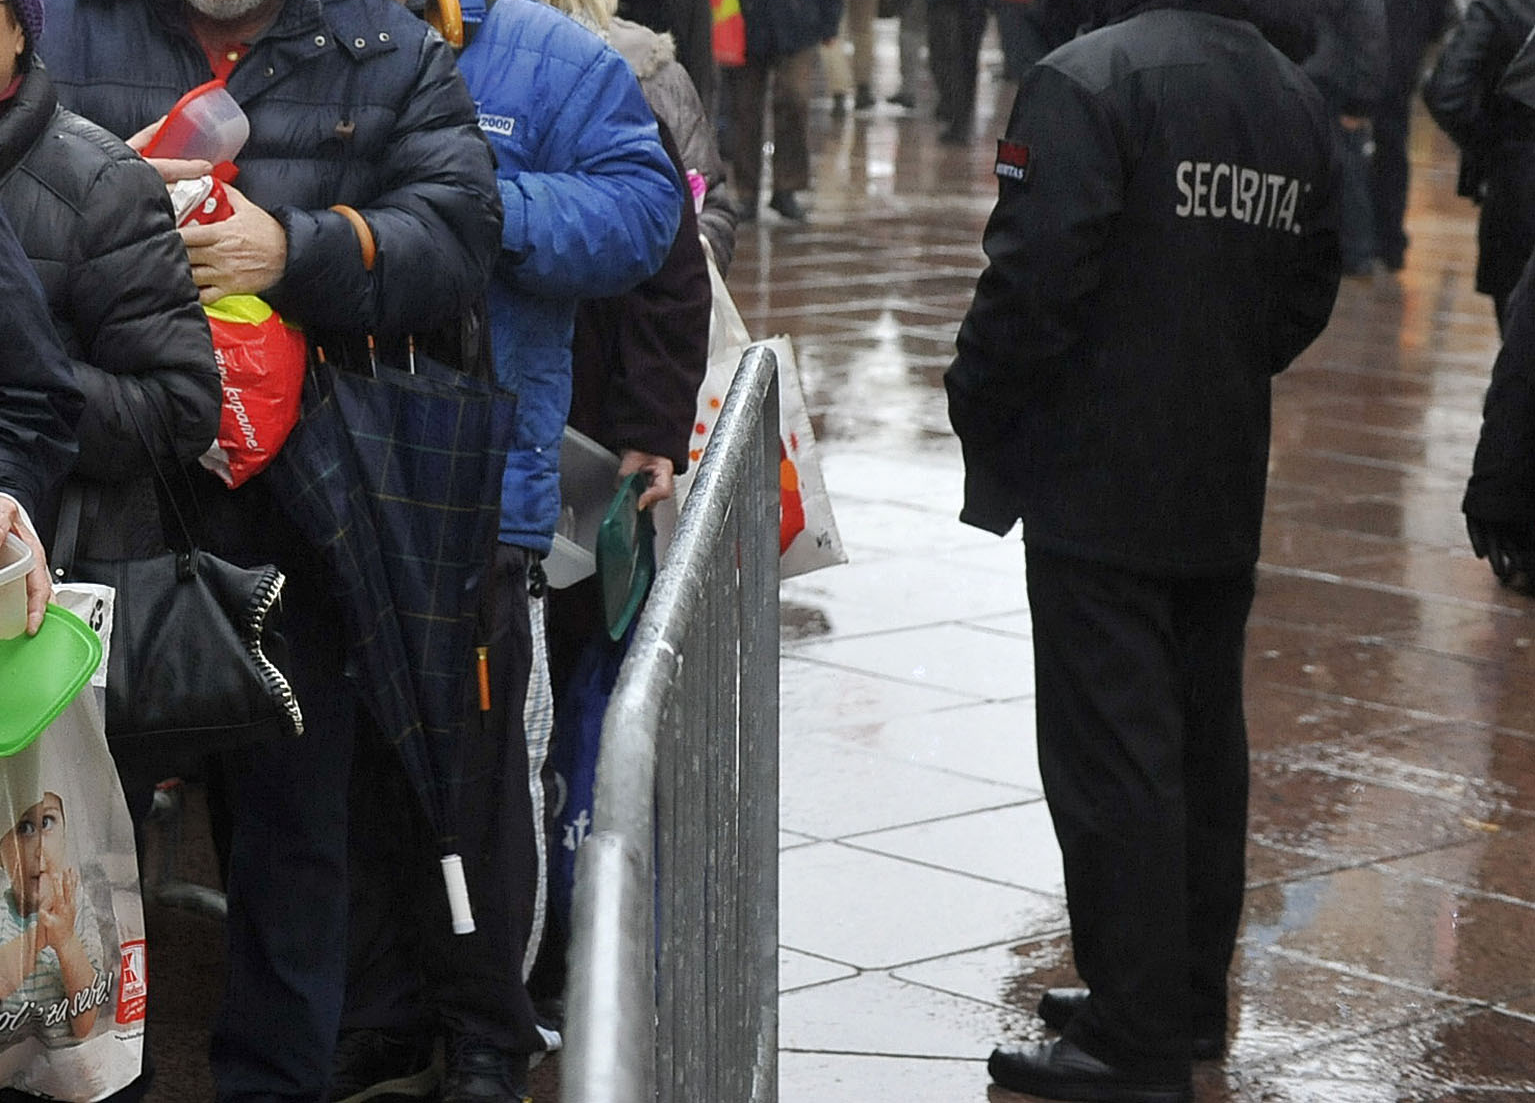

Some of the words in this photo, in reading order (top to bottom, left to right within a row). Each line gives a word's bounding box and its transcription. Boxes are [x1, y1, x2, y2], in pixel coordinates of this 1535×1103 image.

[480, 117, 511, 131] 2000
[1175, 160, 1312, 235] SECURITA
[45, 998, 69, 1027] za
[70, 971, 113, 1017] sebe!
